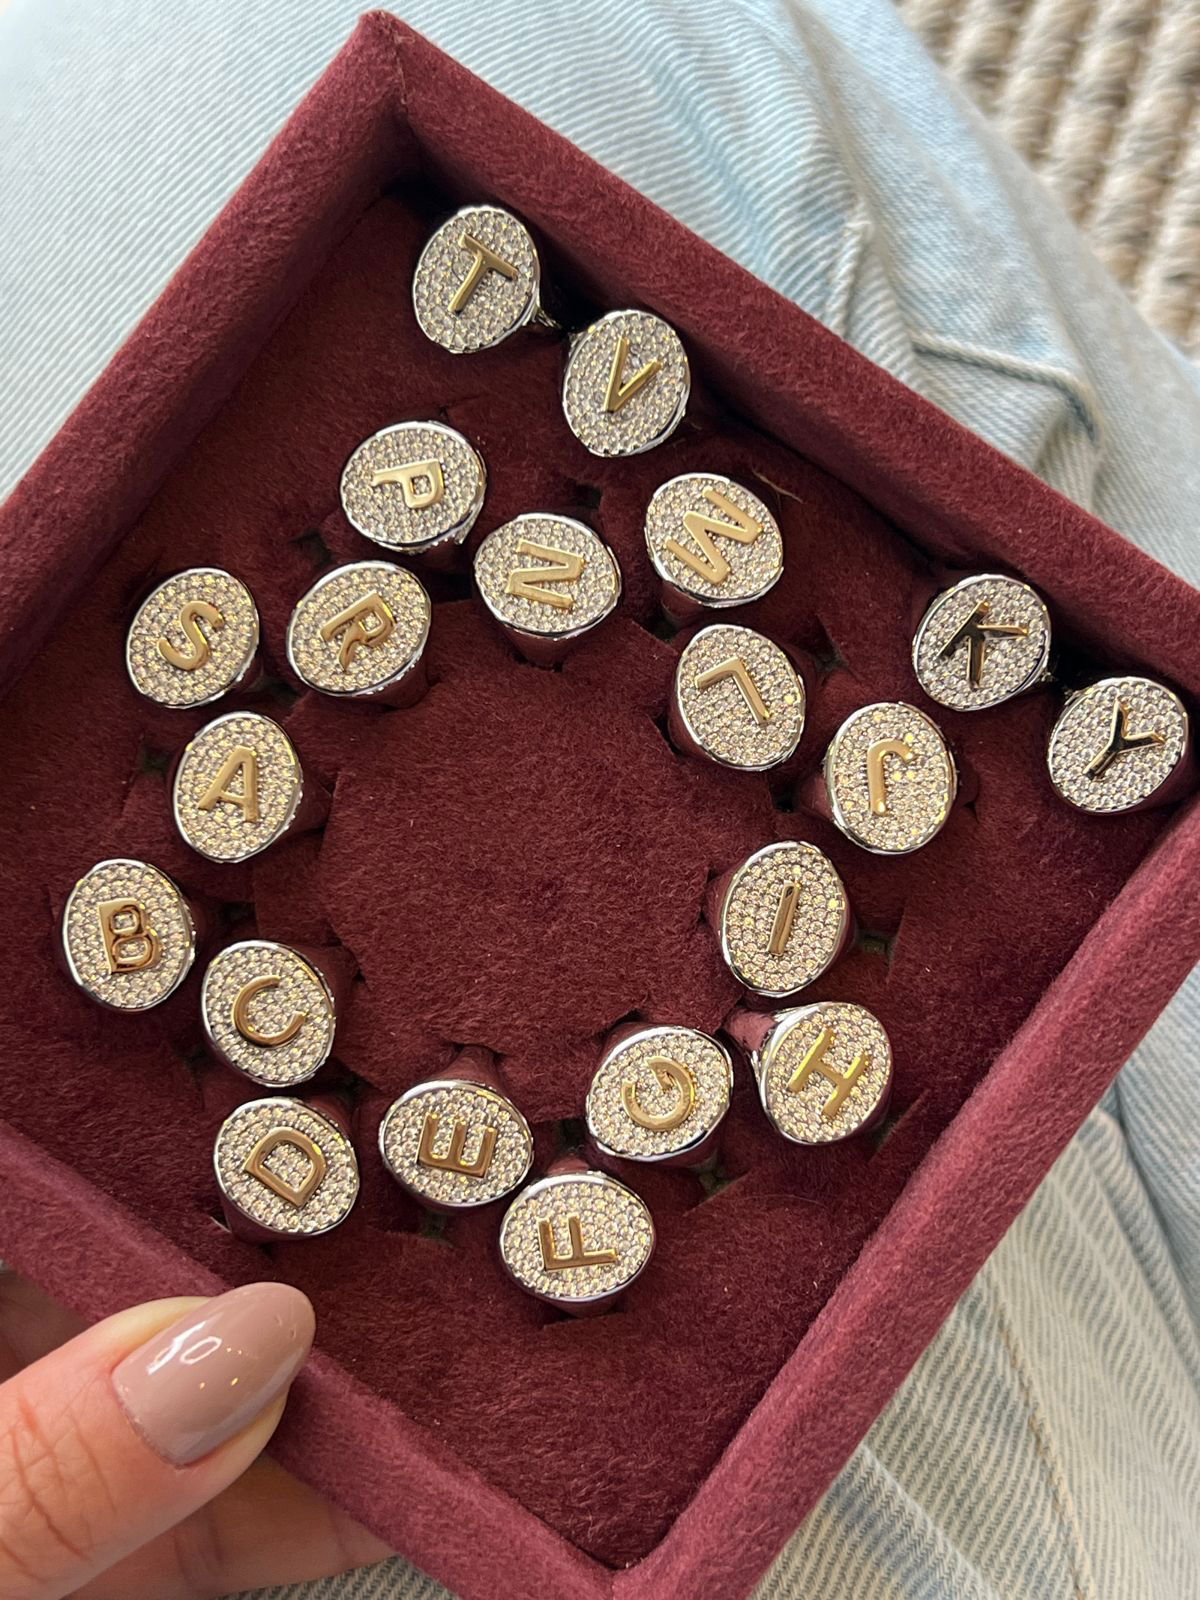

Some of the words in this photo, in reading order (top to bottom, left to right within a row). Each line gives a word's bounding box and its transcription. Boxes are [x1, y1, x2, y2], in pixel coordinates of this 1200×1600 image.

[449, 231, 518, 314] T
[600, 337, 663, 413] V
[372, 458, 445, 510] P
[504, 539, 586, 609] N
[665, 487, 764, 585] M
[157, 600, 224, 670] S
[320, 592, 396, 671] R
[939, 600, 1028, 688] K
[695, 658, 771, 726] L
[866, 738, 912, 815] J
[1083, 697, 1166, 780] Y
[197, 747, 260, 823] A
[98, 899, 161, 975] B
[766, 882, 799, 956] I
[231, 974, 306, 1048] C
[621, 1055, 696, 1131] G
[787, 1027, 870, 1117] H
[243, 1125, 327, 1208] D
[417, 1113, 500, 1178] E
[537, 1214, 618, 1271] F
